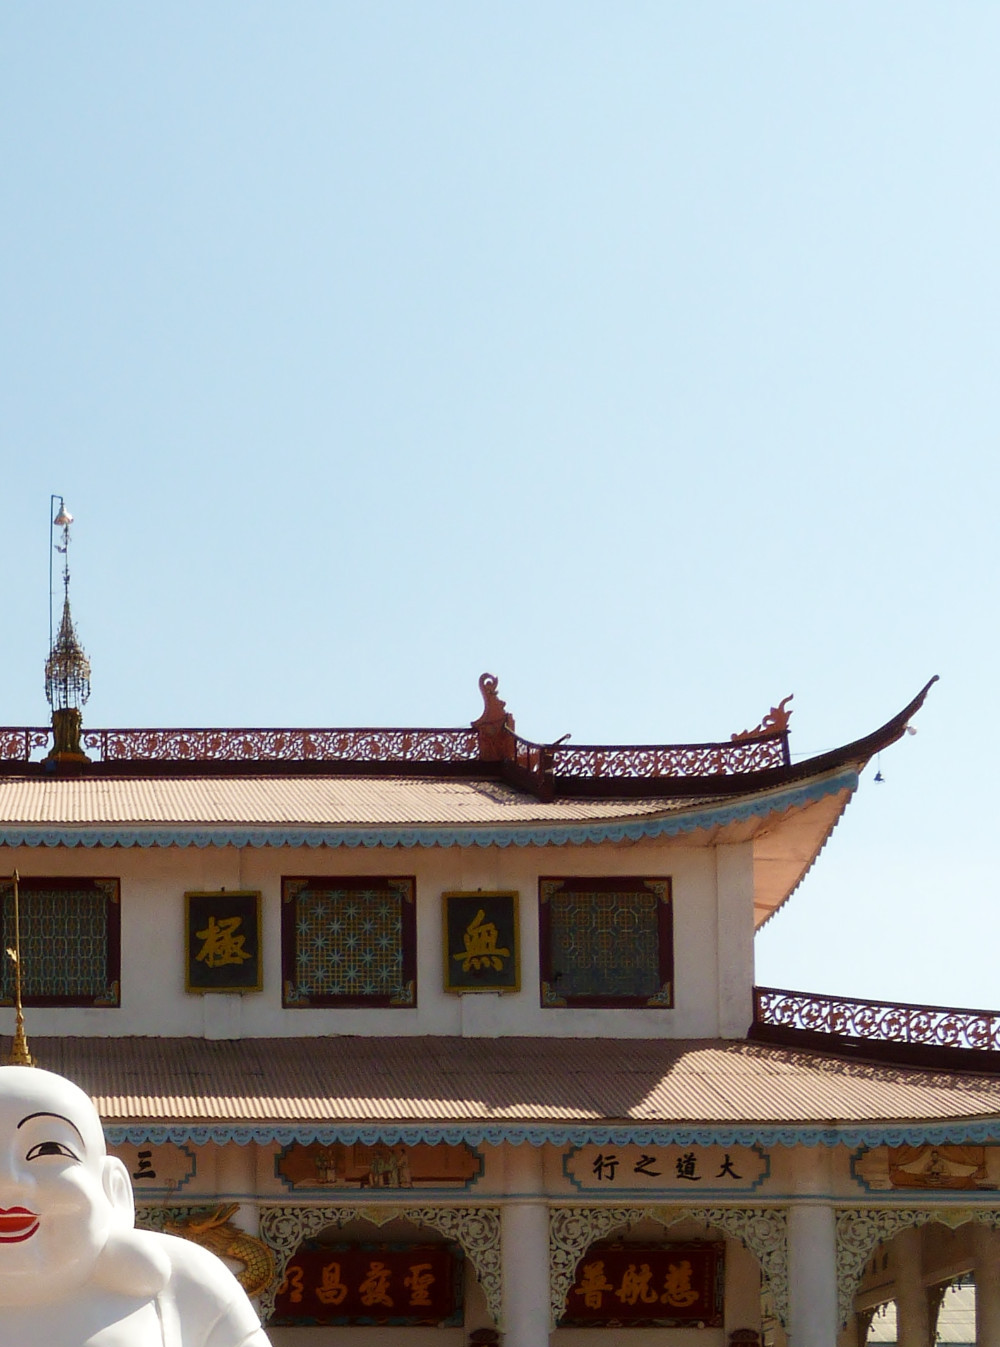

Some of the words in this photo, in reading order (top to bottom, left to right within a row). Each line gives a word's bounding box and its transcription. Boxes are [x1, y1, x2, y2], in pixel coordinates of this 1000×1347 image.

[194, 916, 253, 970] 極
[453, 909, 511, 973] 無
[592, 1151, 743, 1182] 大道之行
[566, 1259, 700, 1310] 慈航普
